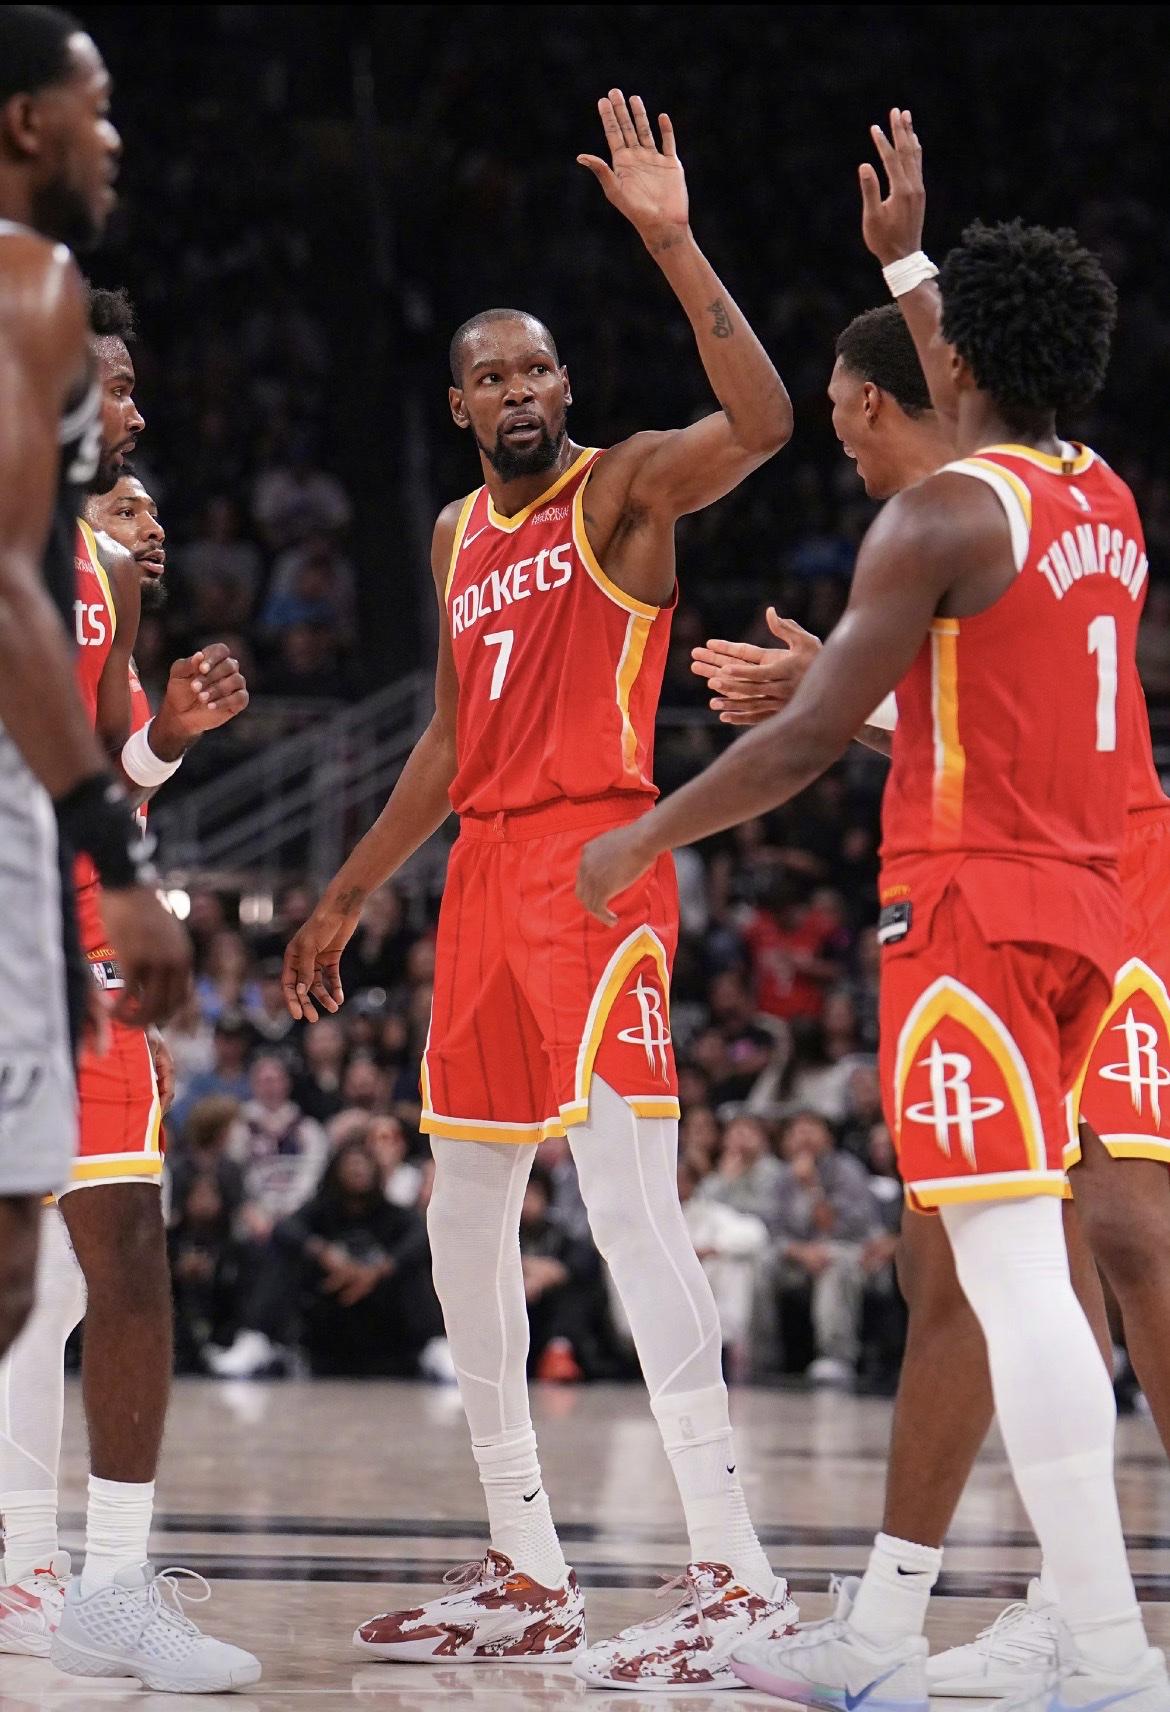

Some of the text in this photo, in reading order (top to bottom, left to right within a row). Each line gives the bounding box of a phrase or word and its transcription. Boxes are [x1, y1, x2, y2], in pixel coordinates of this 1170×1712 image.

[452, 542, 572, 639] ROCKETS
[1037, 523, 1149, 601] THOMPSON
[483, 629, 514, 701] 7
[1087, 615, 1117, 752] 1
